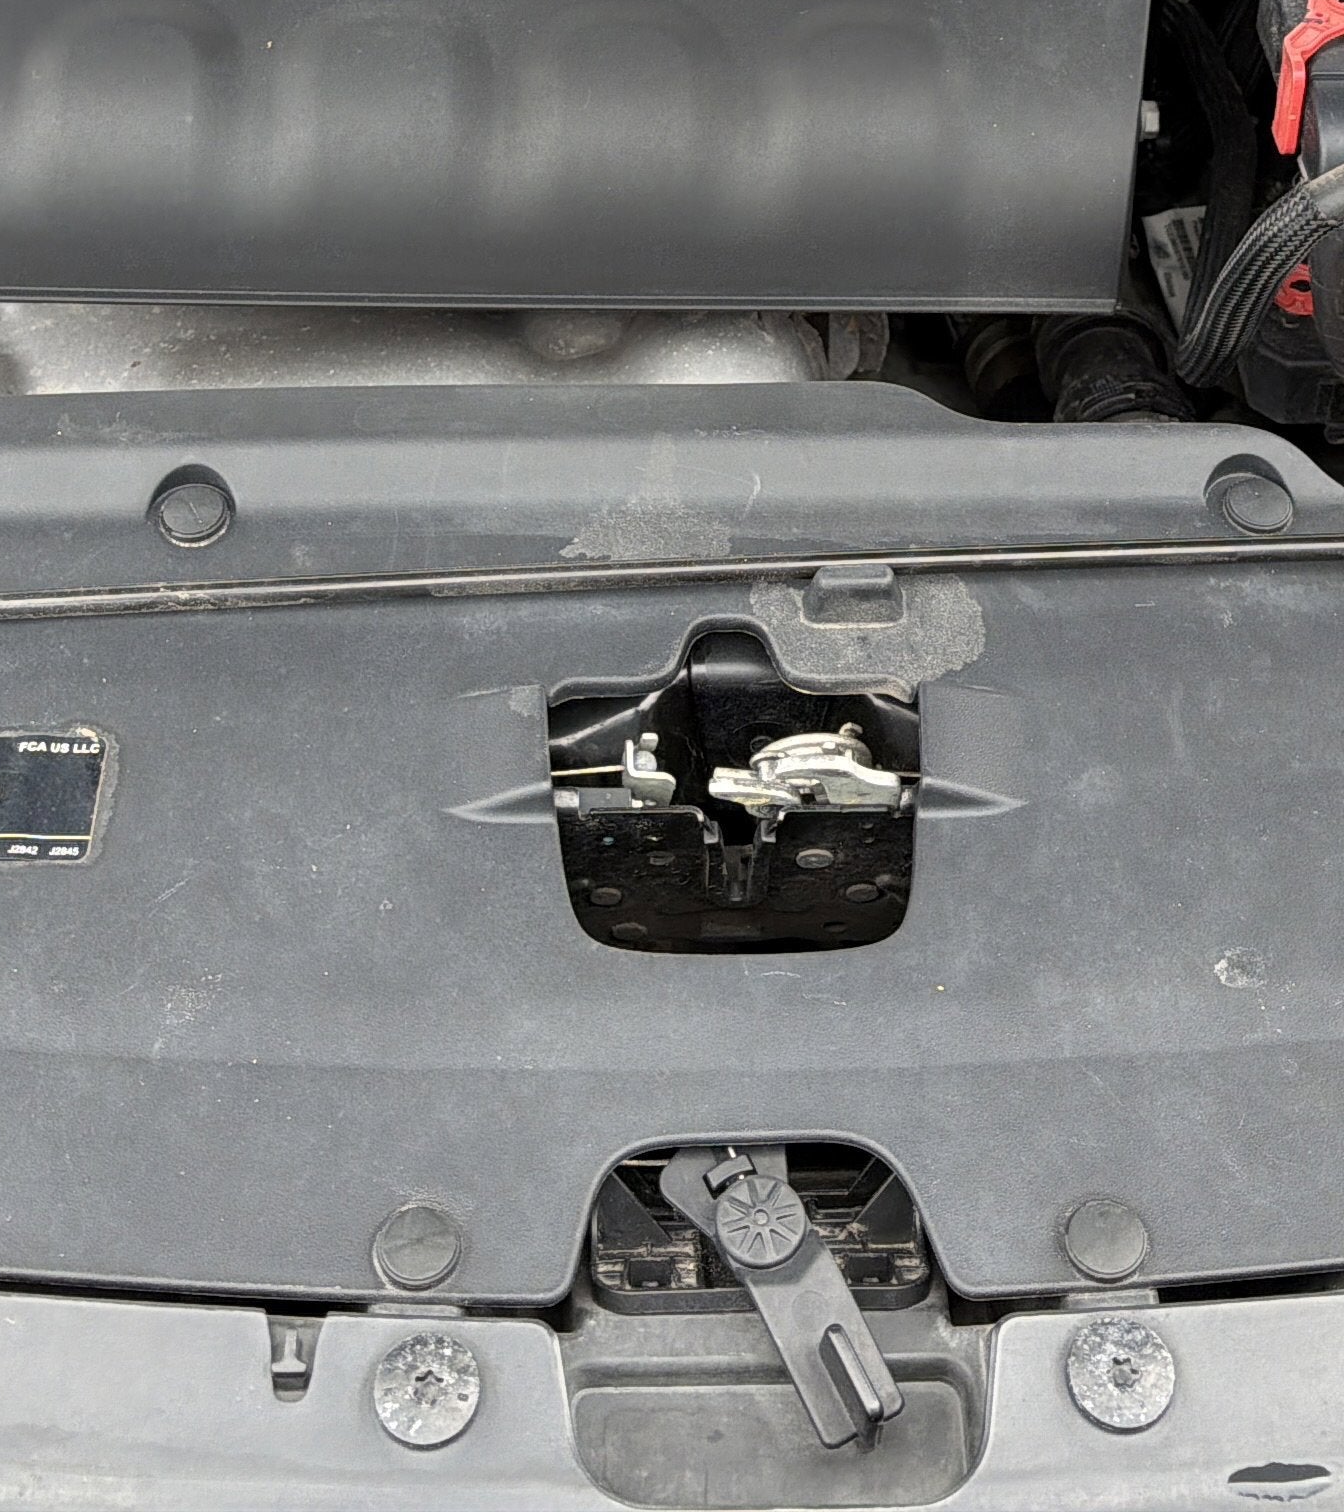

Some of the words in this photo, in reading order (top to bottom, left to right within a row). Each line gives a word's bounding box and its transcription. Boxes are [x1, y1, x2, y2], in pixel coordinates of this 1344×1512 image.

[18, 742, 48, 753] FCA
[50, 742, 70, 753] US
[72, 743, 101, 754] LLC
